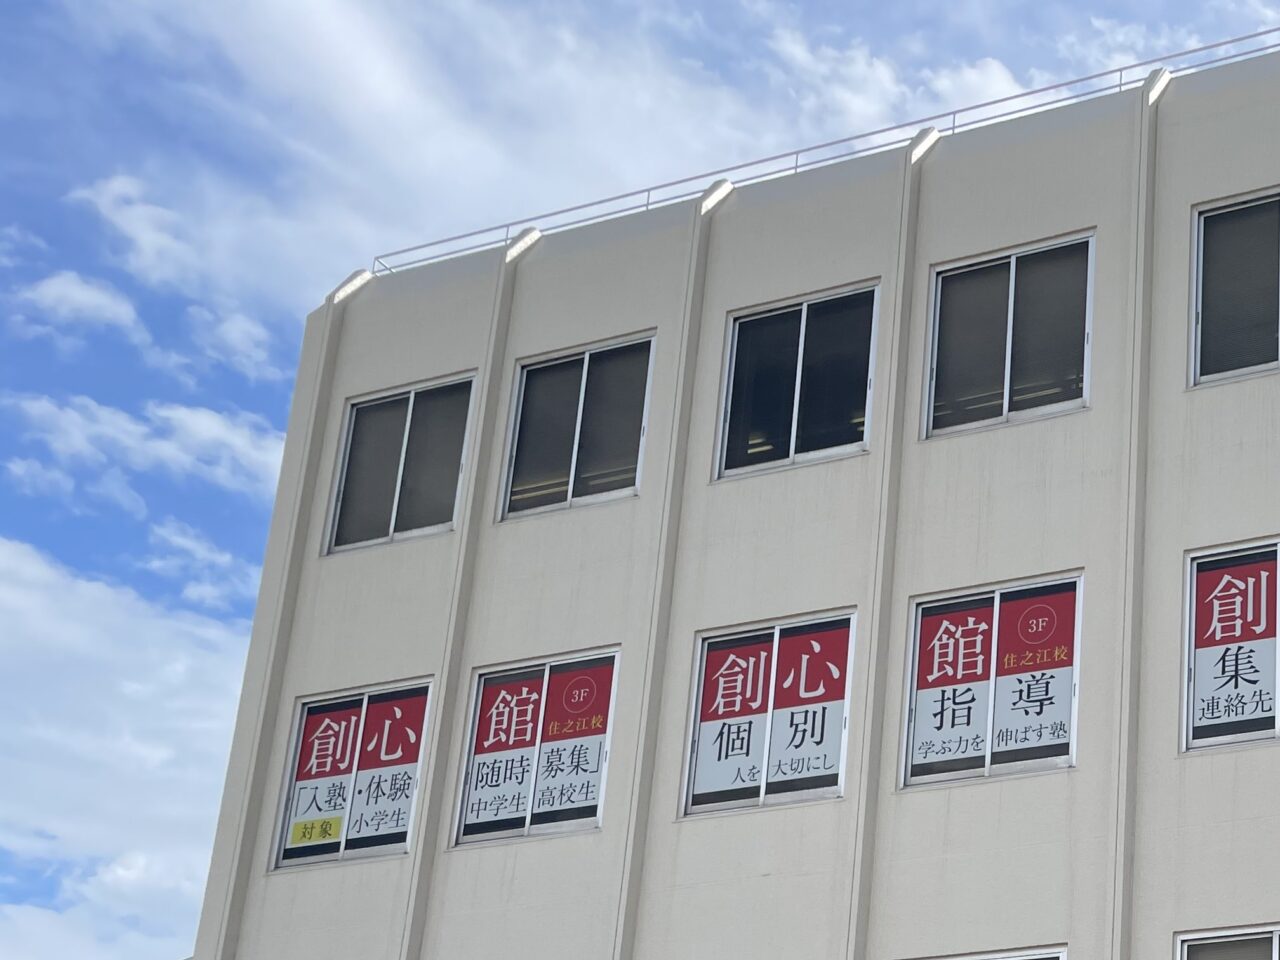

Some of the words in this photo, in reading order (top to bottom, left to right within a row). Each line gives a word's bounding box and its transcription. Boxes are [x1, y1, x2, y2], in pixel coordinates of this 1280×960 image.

[1028, 618, 1048, 633] 3F
[1003, 647, 1068, 669] 住之江校
[569, 688, 590, 703] 3F
[1198, 689, 1274, 722] 連絡先
[547, 714, 604, 736] 住之江校
[300, 822, 333, 840] 対象
[351, 811, 407, 834] 小学生
